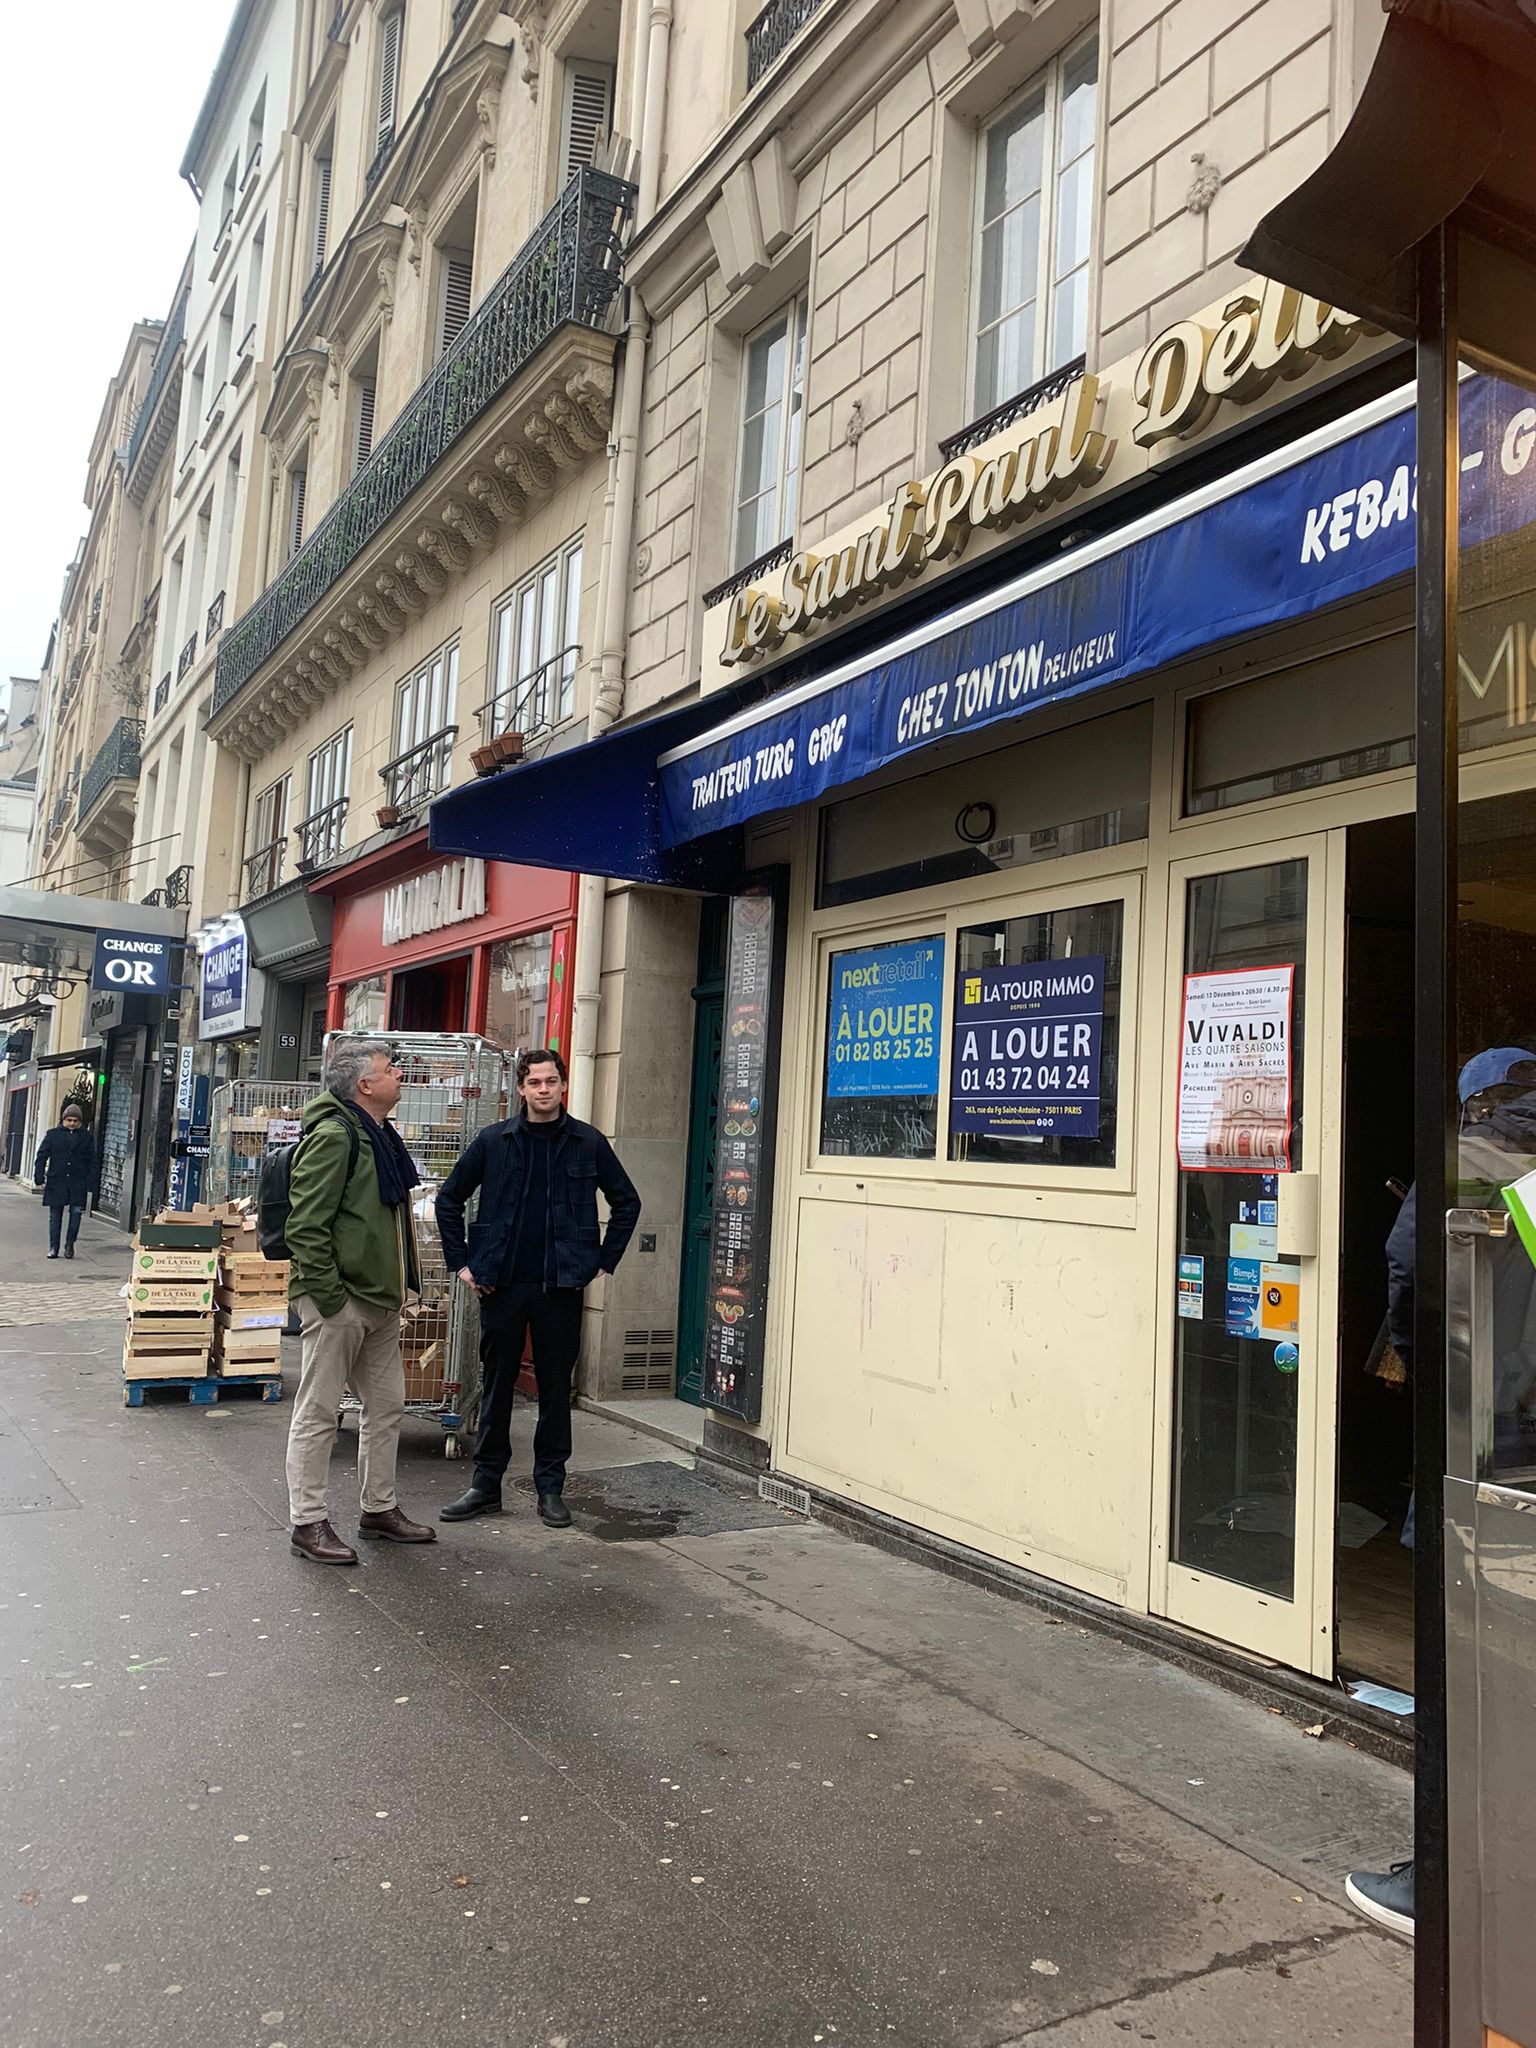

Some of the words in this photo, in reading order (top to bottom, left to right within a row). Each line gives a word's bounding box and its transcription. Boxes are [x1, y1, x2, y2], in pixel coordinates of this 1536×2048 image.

[719, 588, 772, 667] Le
[777, 482, 925, 632] Saint
[925, 373, 1106, 560] Paul
[1300, 464, 1417, 563] KEBA
[897, 681, 948, 744] CHEZ
[953, 640, 1045, 723] TONTON
[691, 755, 751, 810] TRAITEUR
[753, 737, 795, 785] TURC
[103, 938, 163, 955] CHANGE
[105, 958, 156, 986] OR
[206, 943, 241, 983] CHANGE
[226, 988, 233, 1006] OR
[984, 984, 1000, 1003] LA
[1002, 979, 1043, 1001] TOUR
[1046, 974, 1094, 997] IMMO
[1186, 992, 1205, 1000] Samedi
[1213, 990, 1240, 998] Décembre
[836, 1004, 851, 1040] À
[858, 1003, 933, 1038] LOUER
[1188, 1020, 1284, 1043] VIVALDI
[280, 1035, 296, 1047] 59
[835, 1043, 850, 1063] 01
[853, 1042, 870, 1062] 82
[873, 1040, 890, 1060] 83
[893, 1039, 911, 1059] 25
[914, 1037, 933, 1058] 25
[962, 1031, 979, 1061] A
[991, 1023, 1091, 1060] LOUER
[1185, 1046, 1201, 1056] LES
[1206, 1043, 1240, 1056] QUATRE
[1245, 1041, 1285, 1054] SAISONS
[1239, 1059, 1254, 1067] AIRS
[178, 1049, 192, 1107] ABACOR
[961, 1068, 980, 1090] 01
[985, 1067, 1006, 1090] 43
[1011, 1066, 1032, 1090] 72
[1037, 1065, 1060, 1090] 04
[1065, 1065, 1089, 1089] 24
[1183, 1084, 1217, 1092] PACHELBEL
[987, 1106, 994, 1114] du
[994, 1106, 1001, 1116] Fg
[1002, 1106, 1040, 1114] Saint-Antoine
[1045, 1105, 1063, 1114] 75011
[1064, 1105, 1082, 1114] PARIS
[169, 1162, 180, 1184] OR
[1232, 1294, 1254, 1304] sodexo
